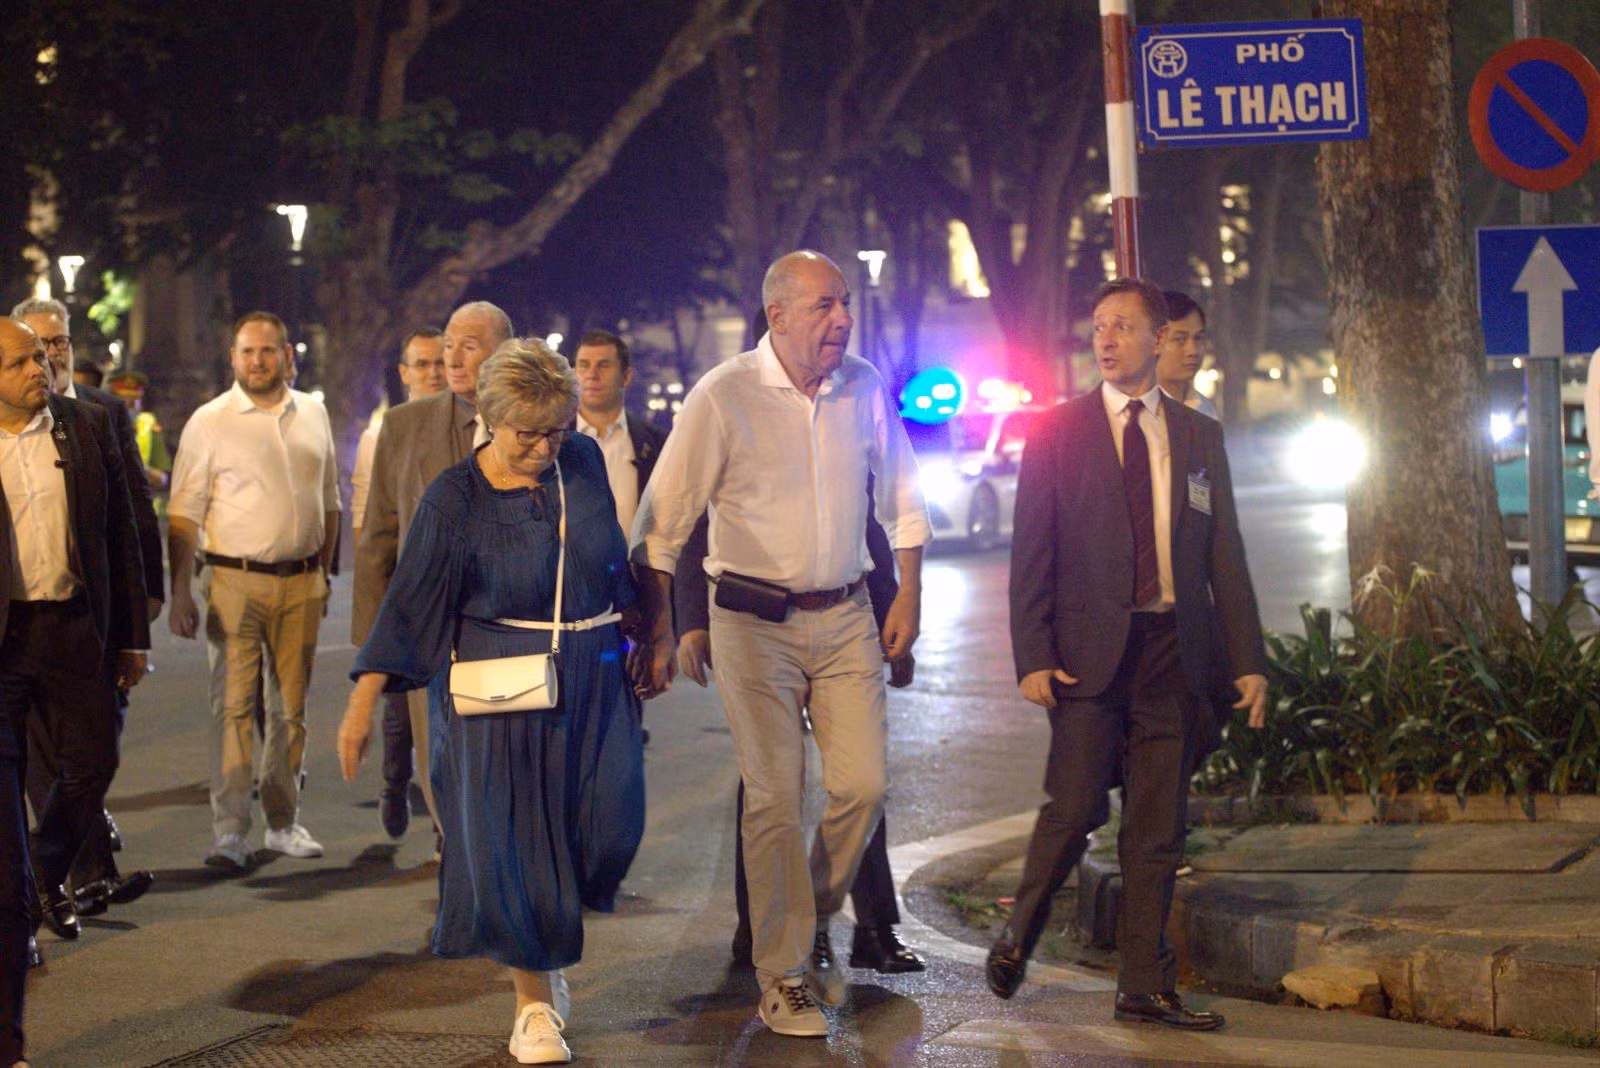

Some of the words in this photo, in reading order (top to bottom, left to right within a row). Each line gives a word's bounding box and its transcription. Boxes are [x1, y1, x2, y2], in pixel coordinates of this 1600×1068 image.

[1236, 33, 1305, 64] PHỐ
[1157, 78, 1205, 128] LÊ
[1214, 81, 1347, 132] THẠCH
